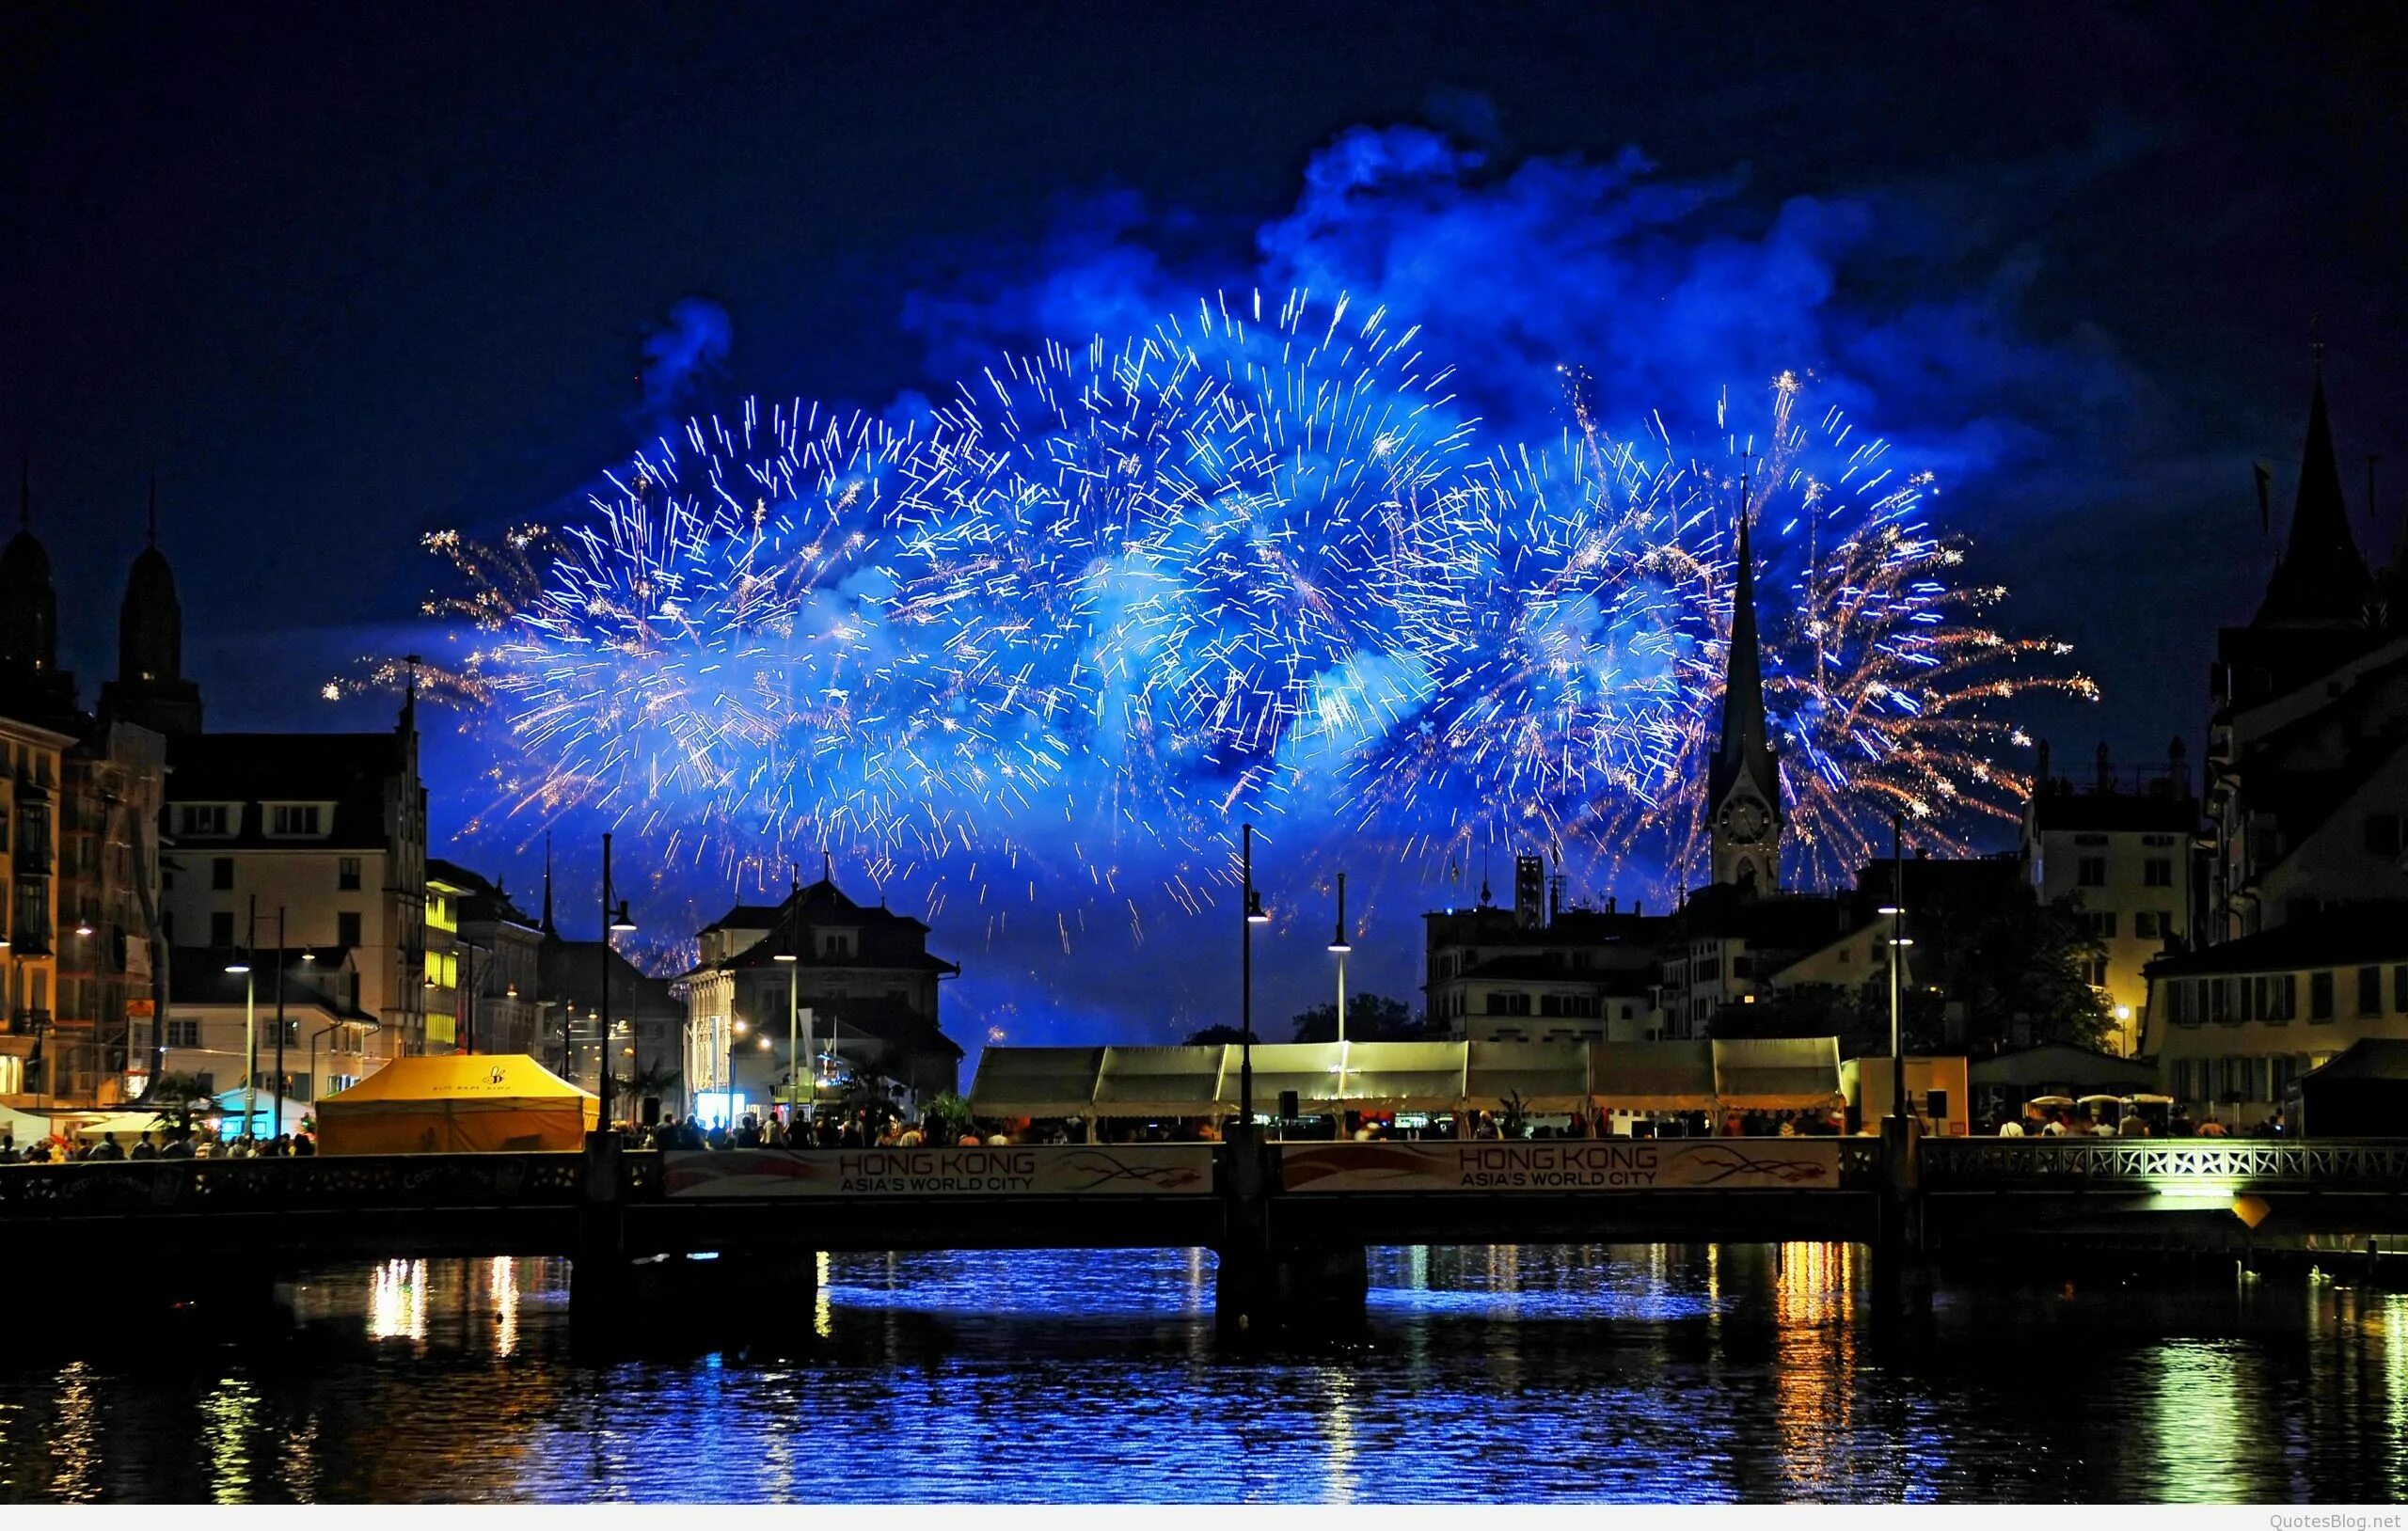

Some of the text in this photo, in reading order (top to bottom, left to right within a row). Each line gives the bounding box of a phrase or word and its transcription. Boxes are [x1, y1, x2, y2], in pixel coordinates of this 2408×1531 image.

[840, 1153, 1035, 1176] HONG KONG
[1460, 1146, 1657, 1170] HONG KONG
[841, 1176, 1035, 1192] ASIA'S WORLD CITY
[1461, 1171, 1656, 1186] ASIA'S WORLD CITY
